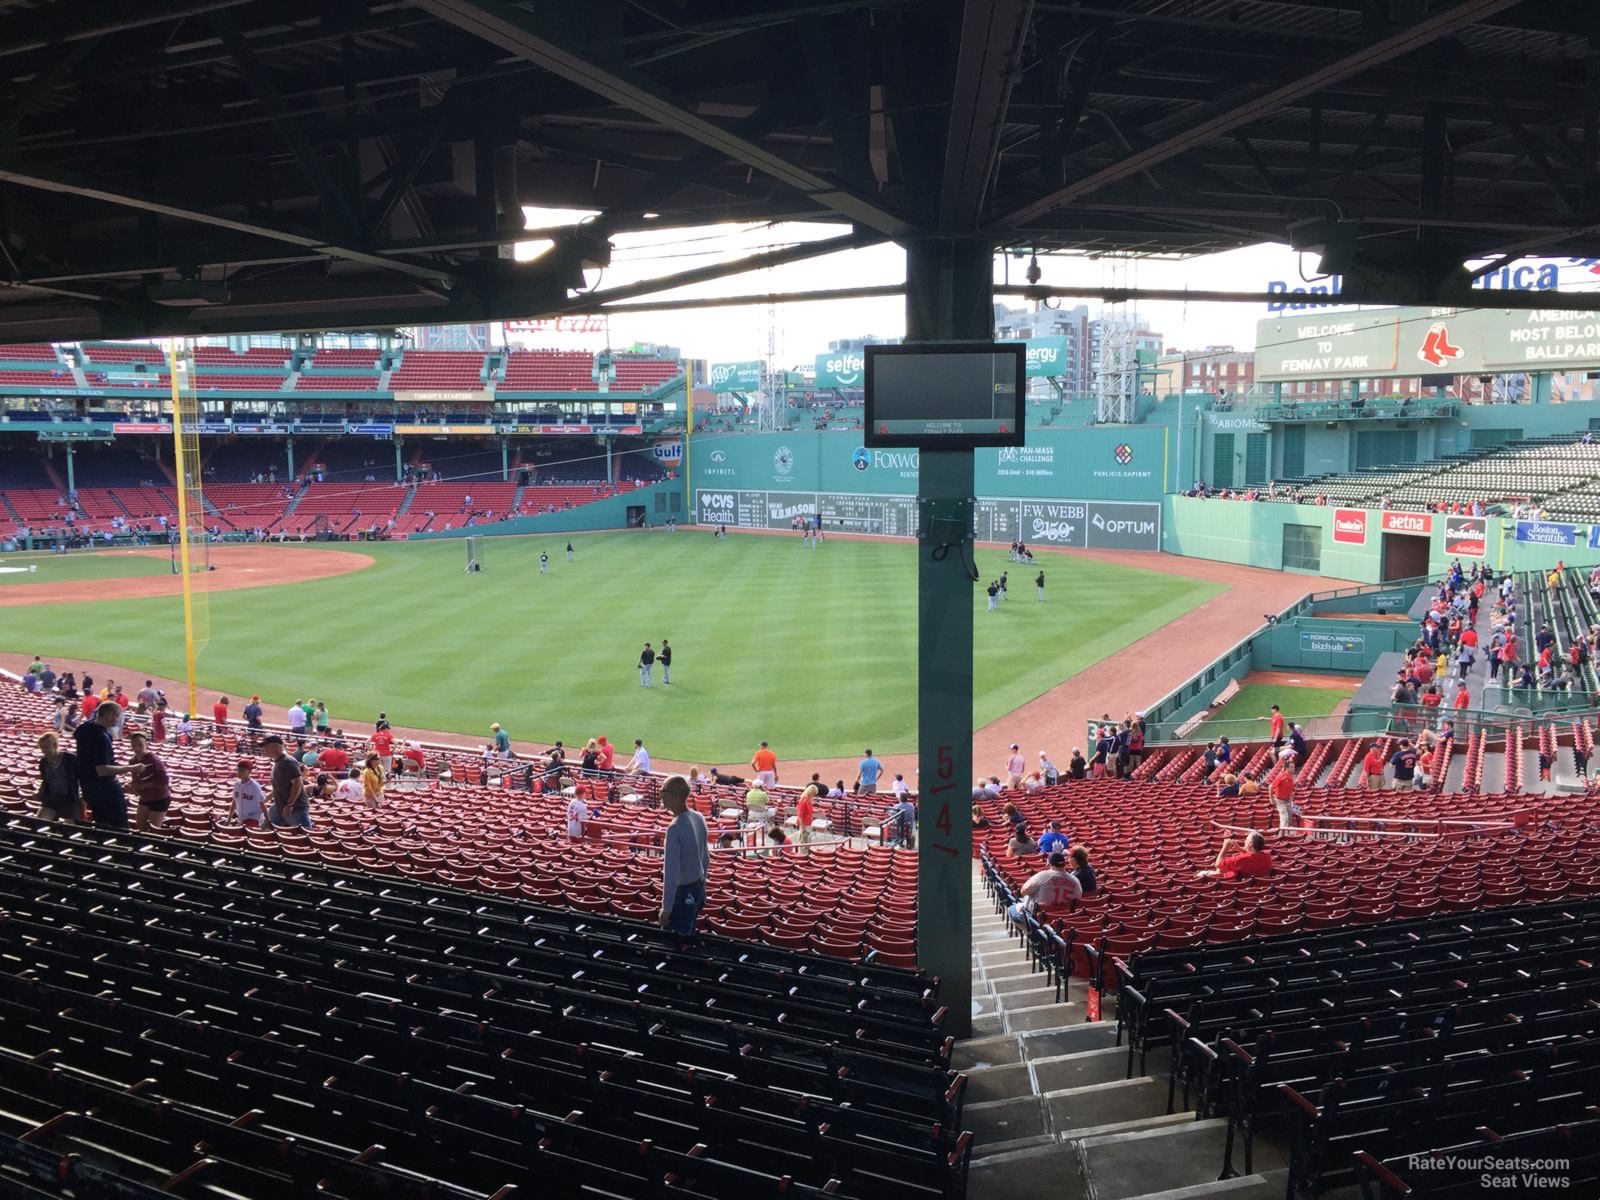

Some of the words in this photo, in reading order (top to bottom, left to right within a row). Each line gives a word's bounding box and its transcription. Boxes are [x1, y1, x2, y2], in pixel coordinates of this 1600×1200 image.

[1472, 263, 1559, 291] rica
[1298, 323, 1355, 339] WELCOME
[1510, 327, 1550, 342] MOST
[1317, 341, 1333, 353] TO
[1281, 357, 1331, 371] FENWAY
[1334, 355, 1369, 369] PARK
[654, 444, 682, 457] Gulf
[1020, 447, 1054, 455] PAN-MASS
[874, 450, 919, 469] FOXWO
[1020, 455, 1054, 463] CHALLENGE
[711, 494, 734, 509] CVS
[702, 508, 735, 523] Health
[1047, 505, 1085, 519] WEBB
[1106, 520, 1155, 535] OPTUM
[1388, 514, 1425, 531] aetna
[1532, 523, 1559, 535] Boston
[1446, 527, 1485, 541] Safelite
[1527, 528, 1568, 544] Scientific
[1309, 633, 1335, 642] KONICA
[1336, 634, 1364, 643] MINOLTA
[1311, 641, 1344, 652] bizhub
[937, 745, 954, 780] 5
[935, 802, 953, 837] 4
